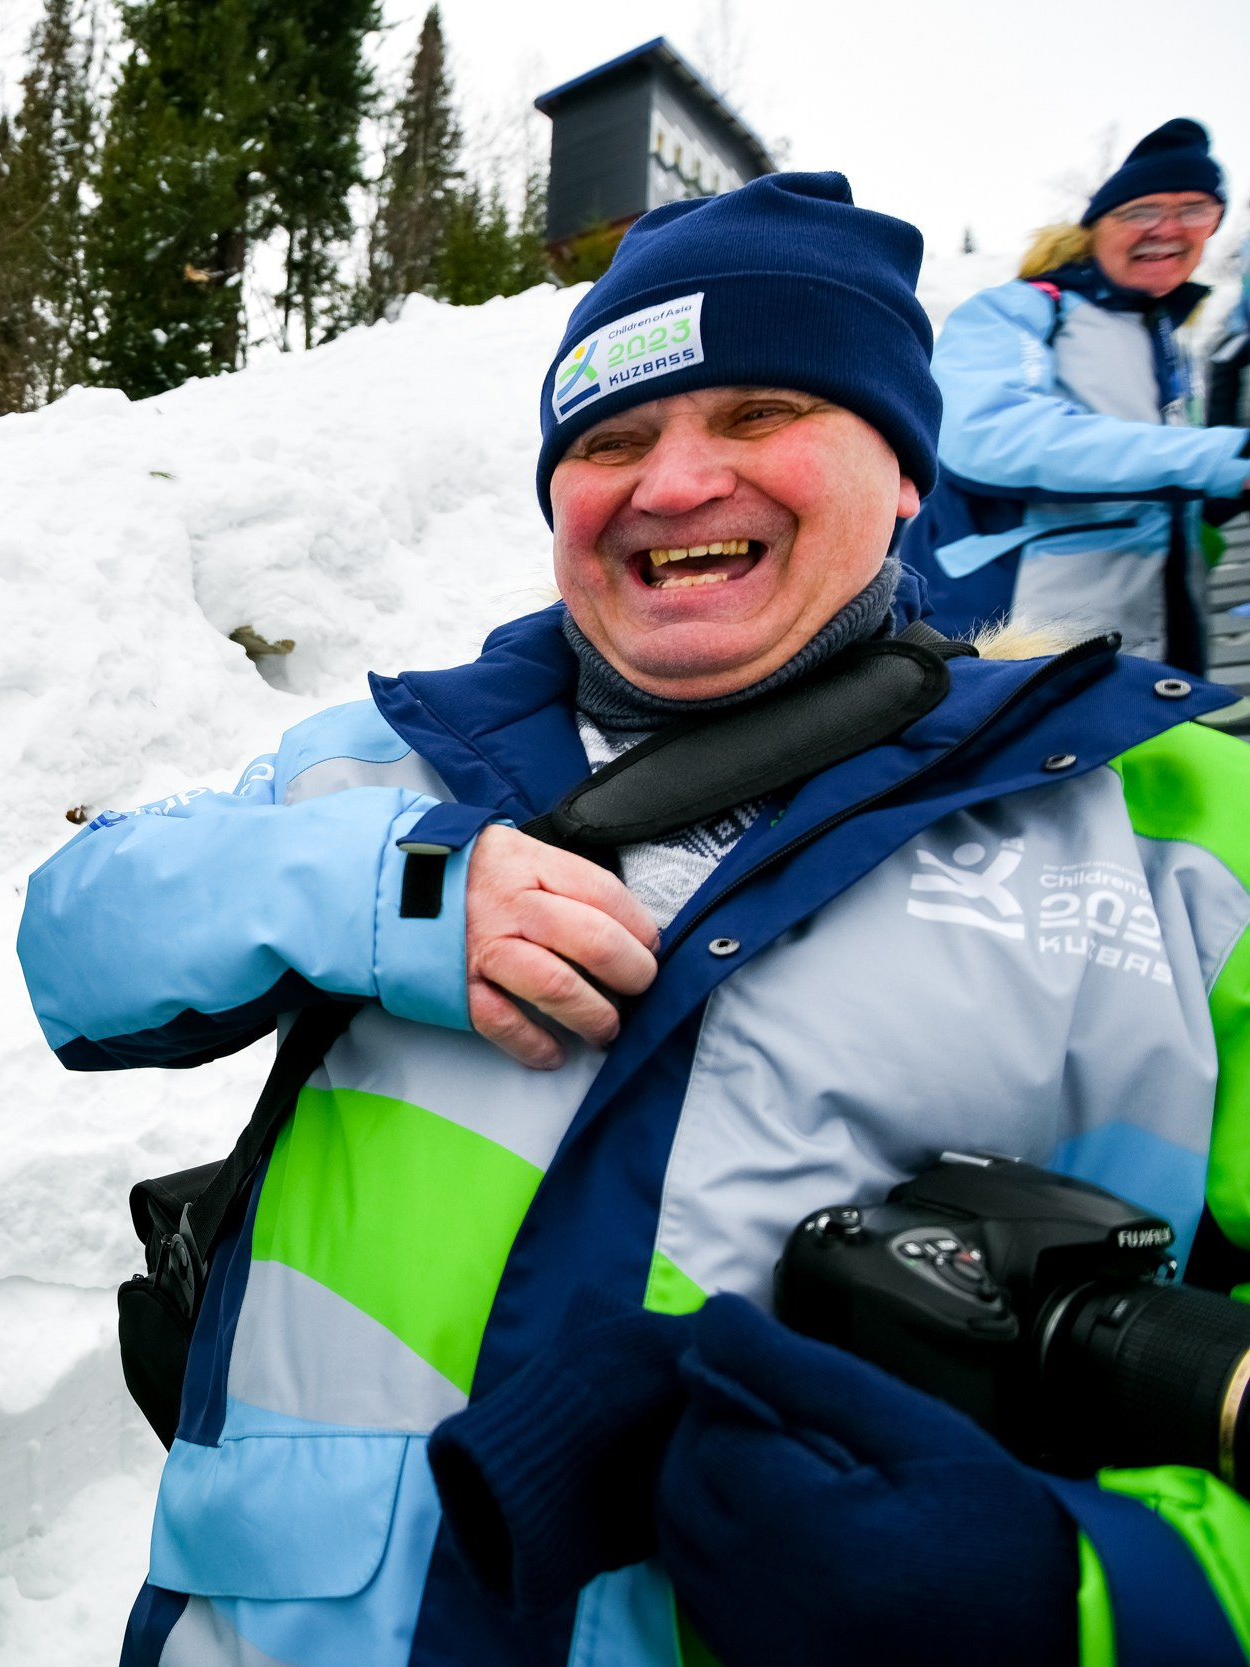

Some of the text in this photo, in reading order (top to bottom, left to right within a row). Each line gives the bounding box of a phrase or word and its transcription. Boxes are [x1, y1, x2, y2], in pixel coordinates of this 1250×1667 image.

[608, 305, 692, 339] Children of Asia
[608, 319, 691, 369] 2023
[609, 348, 695, 386] KUZBASS
[1039, 870, 1138, 896] Children
[1138, 886, 1152, 902] o
[1039, 890, 1162, 953] 202
[1038, 935, 1173, 986] KUBAS
